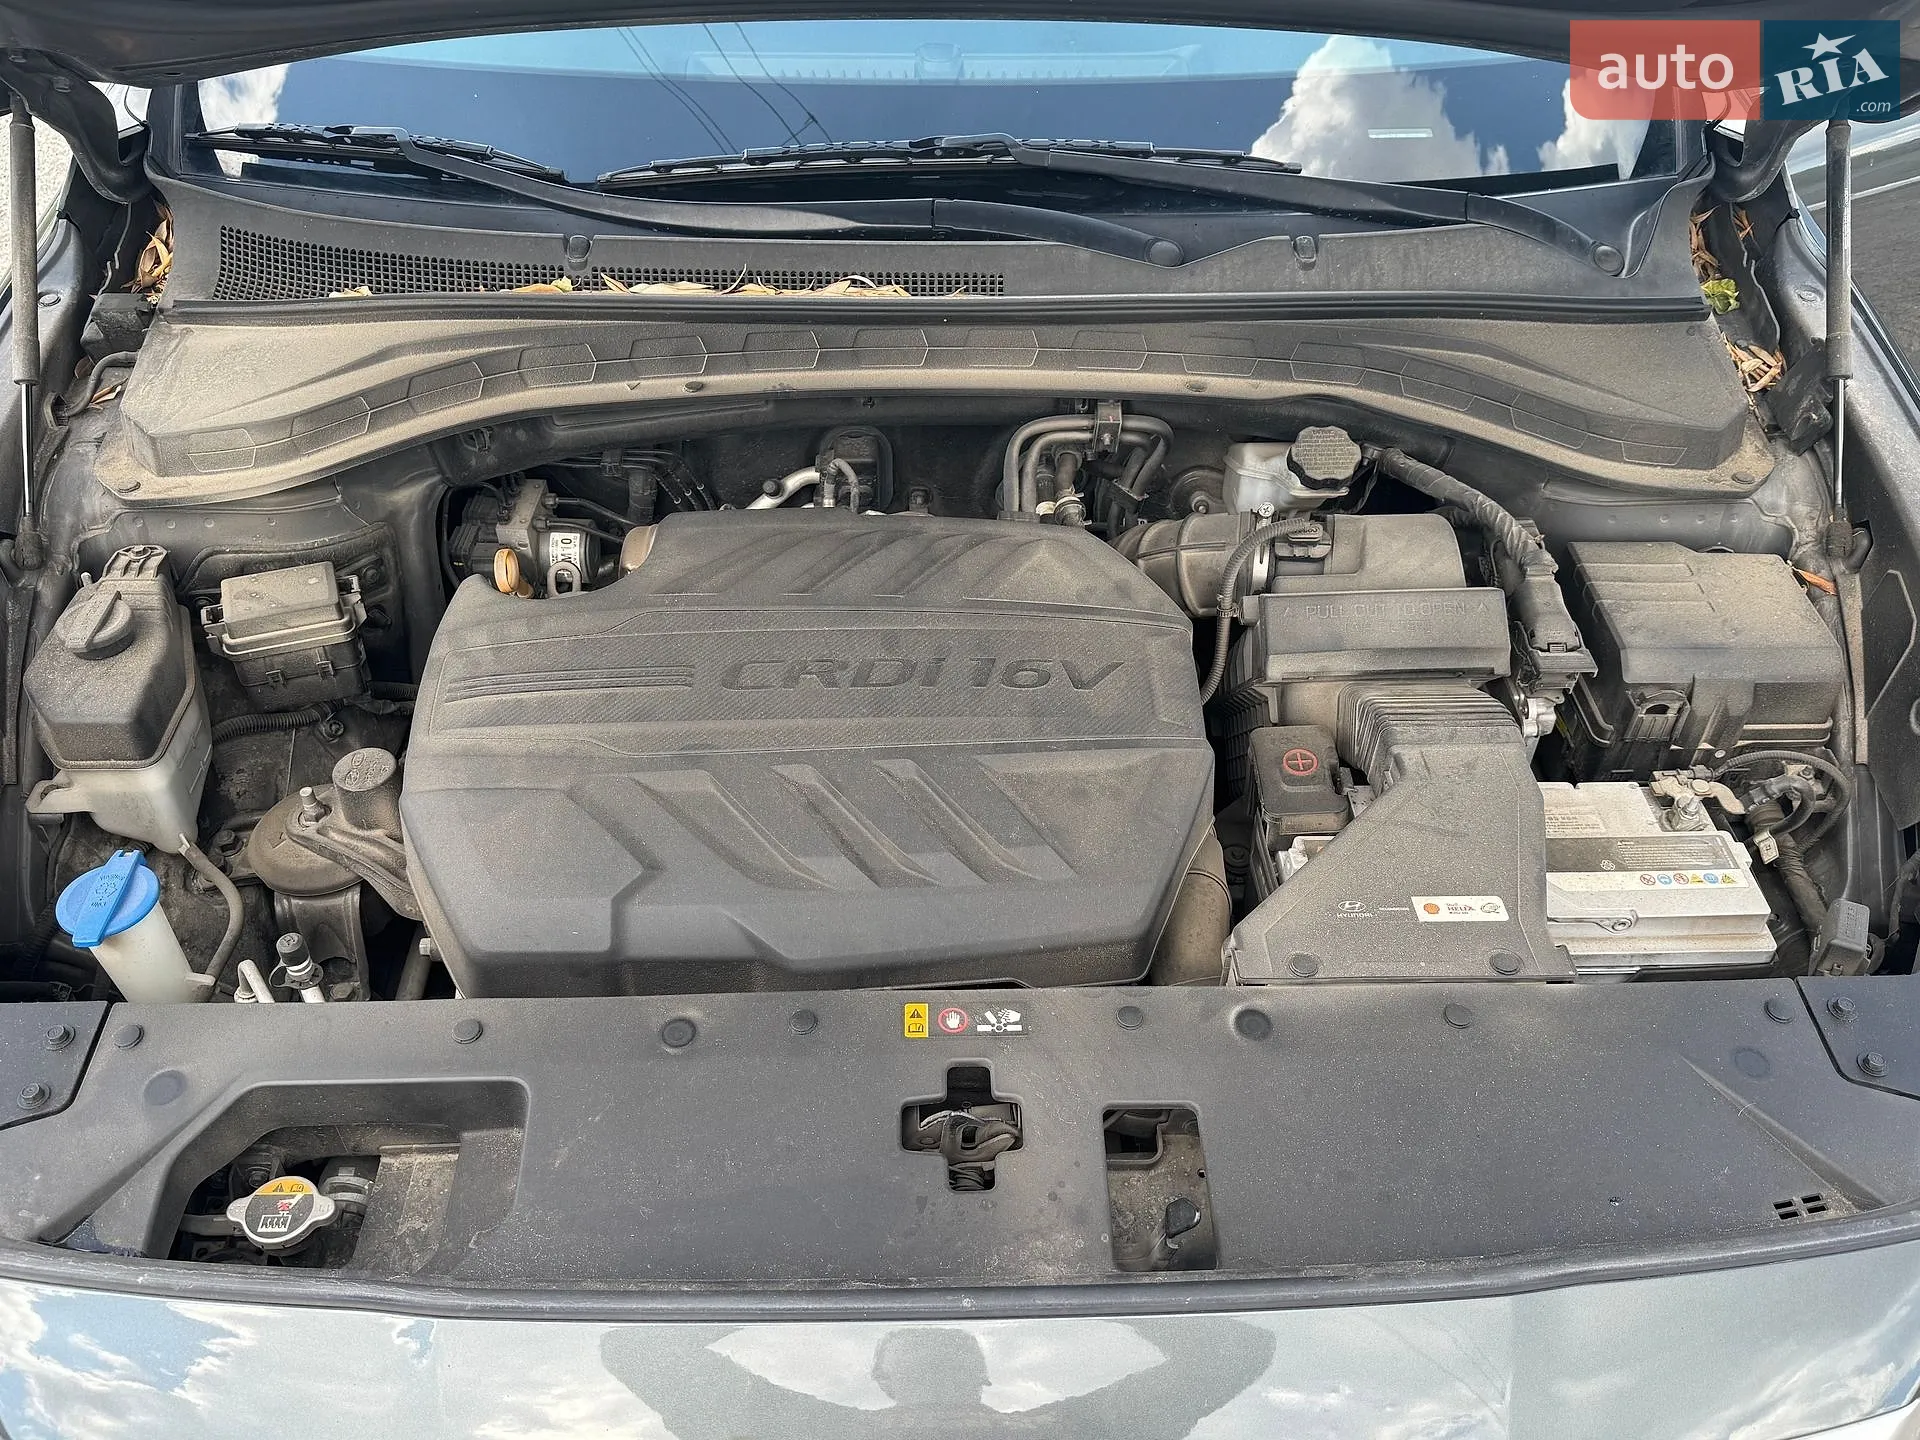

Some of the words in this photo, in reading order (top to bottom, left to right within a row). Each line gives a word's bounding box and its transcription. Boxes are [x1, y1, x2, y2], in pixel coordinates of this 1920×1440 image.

[1305, 604, 1349, 619] PULL
[1354, 603, 1387, 618] OUT
[1419, 601, 1466, 616] OPEN
[969, 656, 1125, 691] 16V
